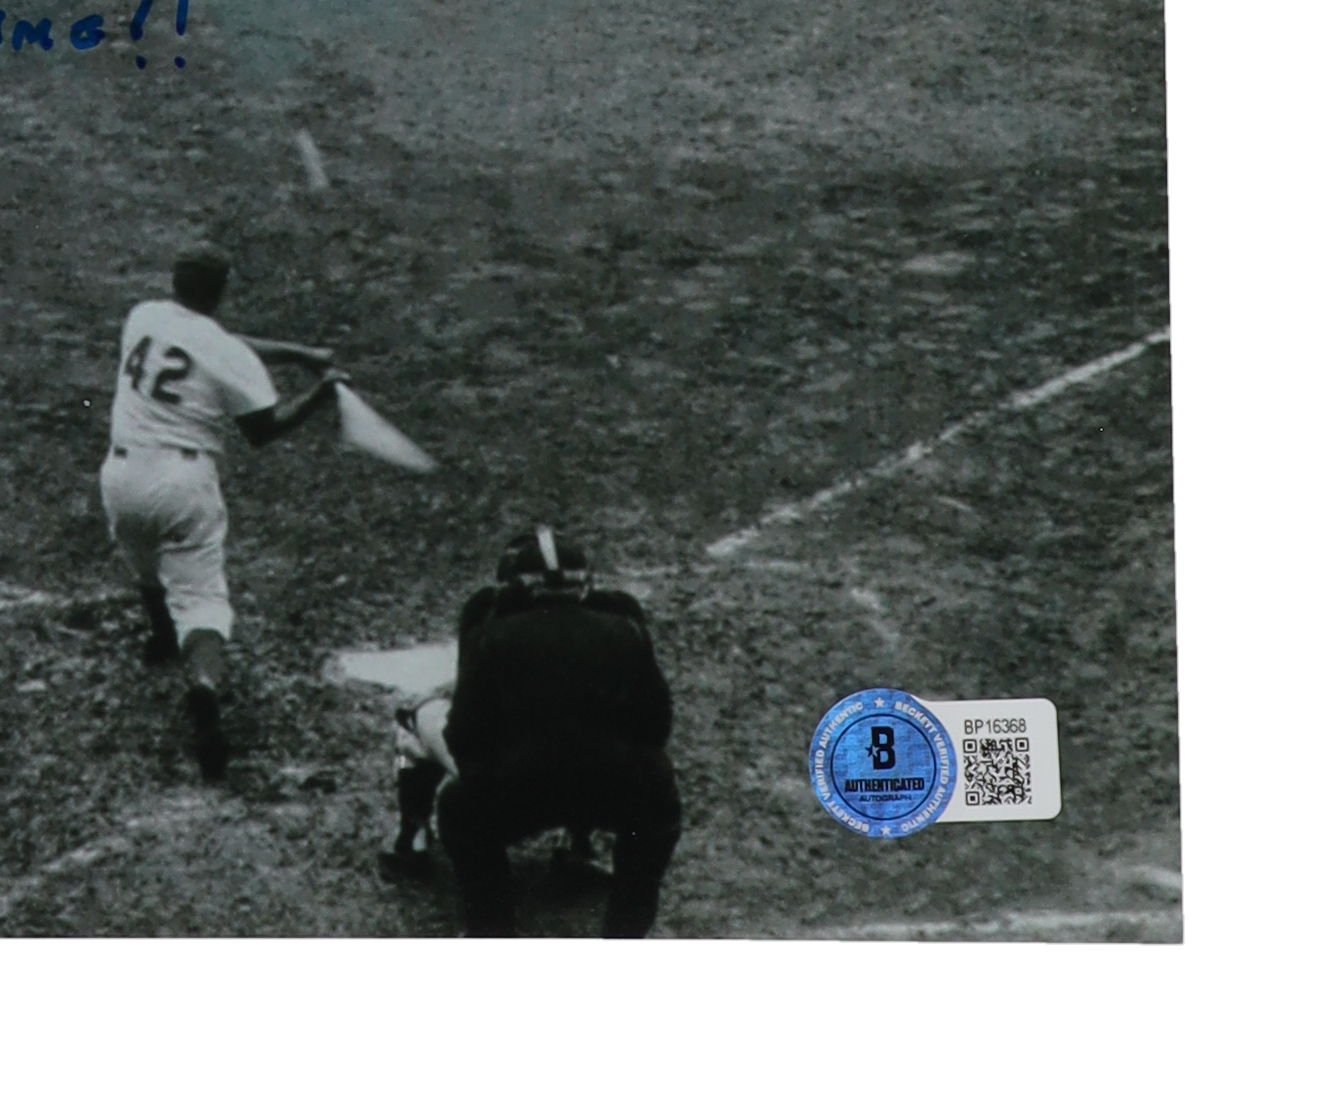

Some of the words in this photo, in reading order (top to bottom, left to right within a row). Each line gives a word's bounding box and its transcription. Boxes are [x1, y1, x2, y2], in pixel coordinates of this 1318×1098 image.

[124, 336, 195, 403] 42
[894, 700, 938, 734] BECKETT
[933, 732, 950, 785] VERIFIED
[963, 718, 1028, 735] BP16368
[844, 777, 925, 793] AUTHENTICATED
